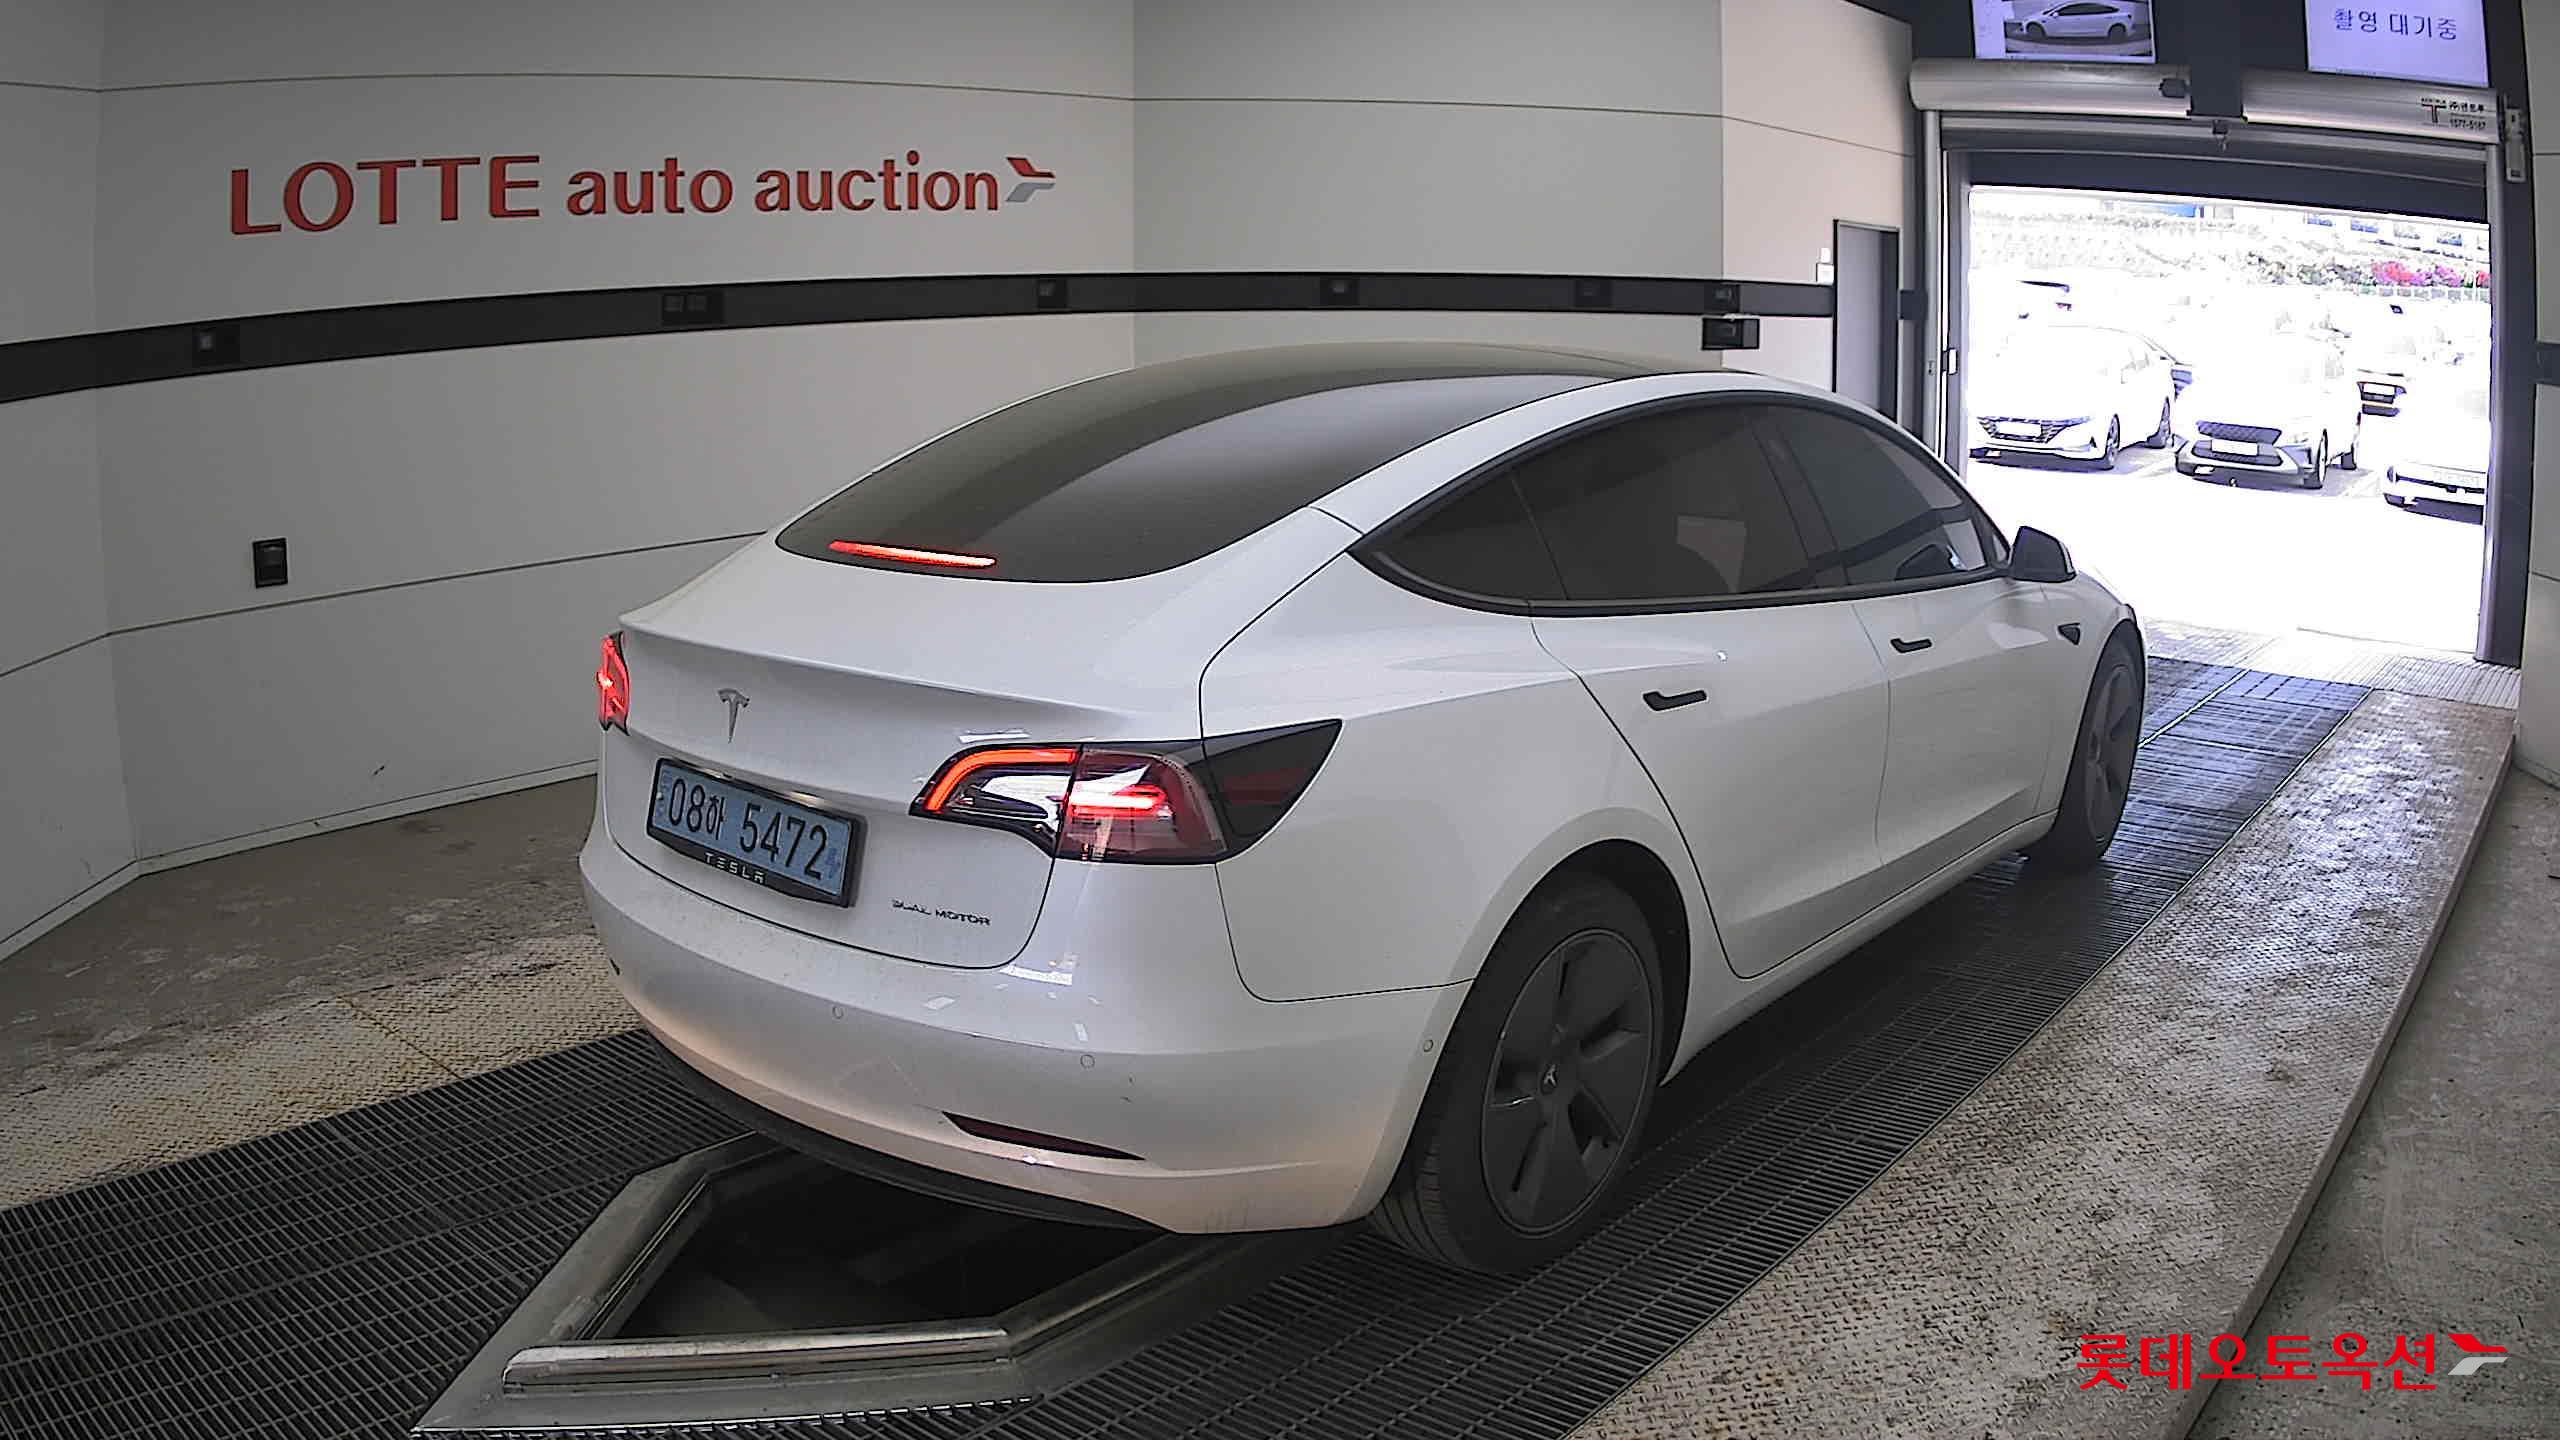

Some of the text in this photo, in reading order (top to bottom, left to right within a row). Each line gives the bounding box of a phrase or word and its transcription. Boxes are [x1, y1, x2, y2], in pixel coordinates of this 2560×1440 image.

[2335, 9, 2457, 40] 촬영 대기중
[231, 150, 1001, 236] LOTTE auto auction
[668, 777, 828, 881] 08하 5472
[703, 852, 767, 884] TESLA
[935, 909, 990, 926] MOTOR
